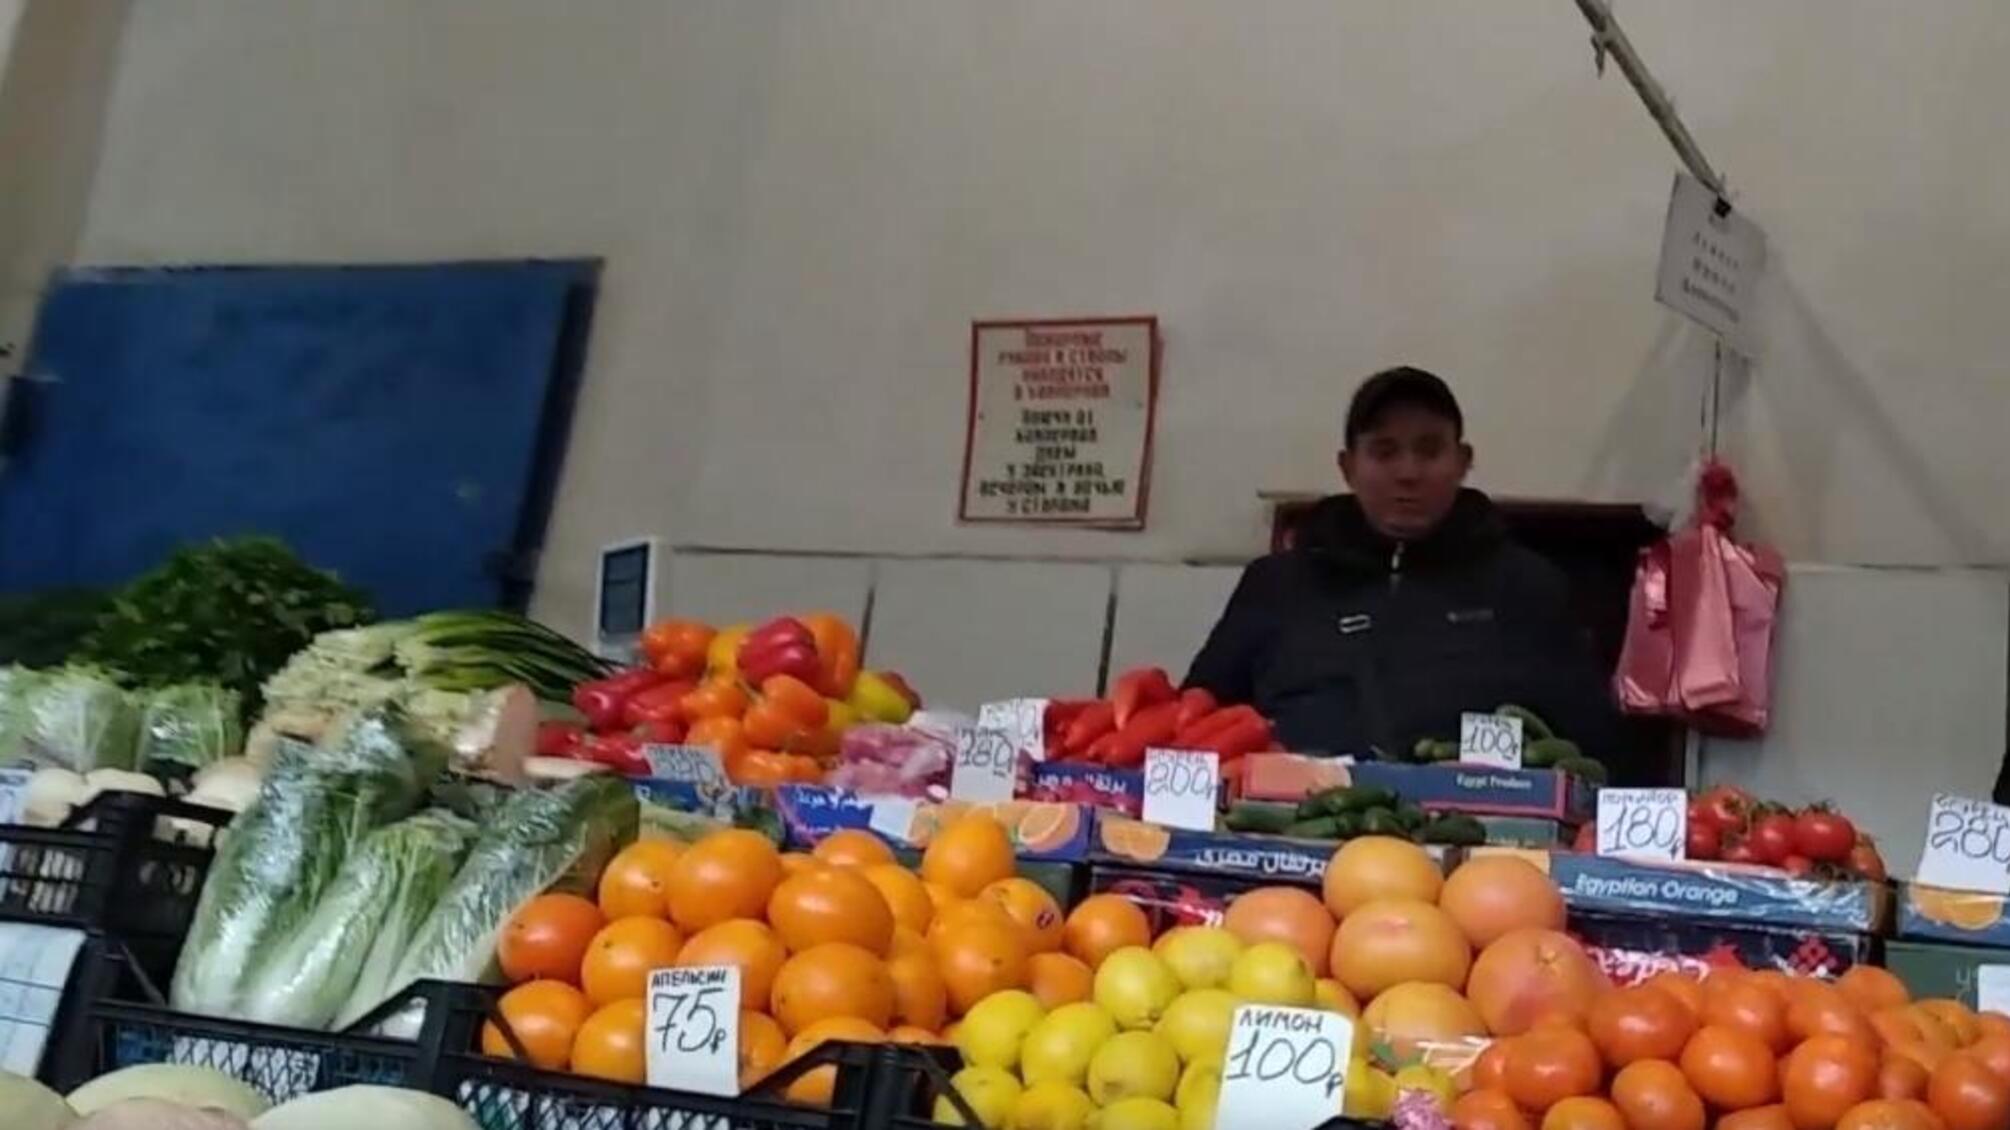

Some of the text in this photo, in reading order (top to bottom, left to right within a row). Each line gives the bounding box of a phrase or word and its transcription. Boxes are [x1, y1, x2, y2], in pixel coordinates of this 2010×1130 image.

[1574, 872, 1739, 905] Egyptian Orange
[1239, 1008, 1324, 1033] ЛИМОН
